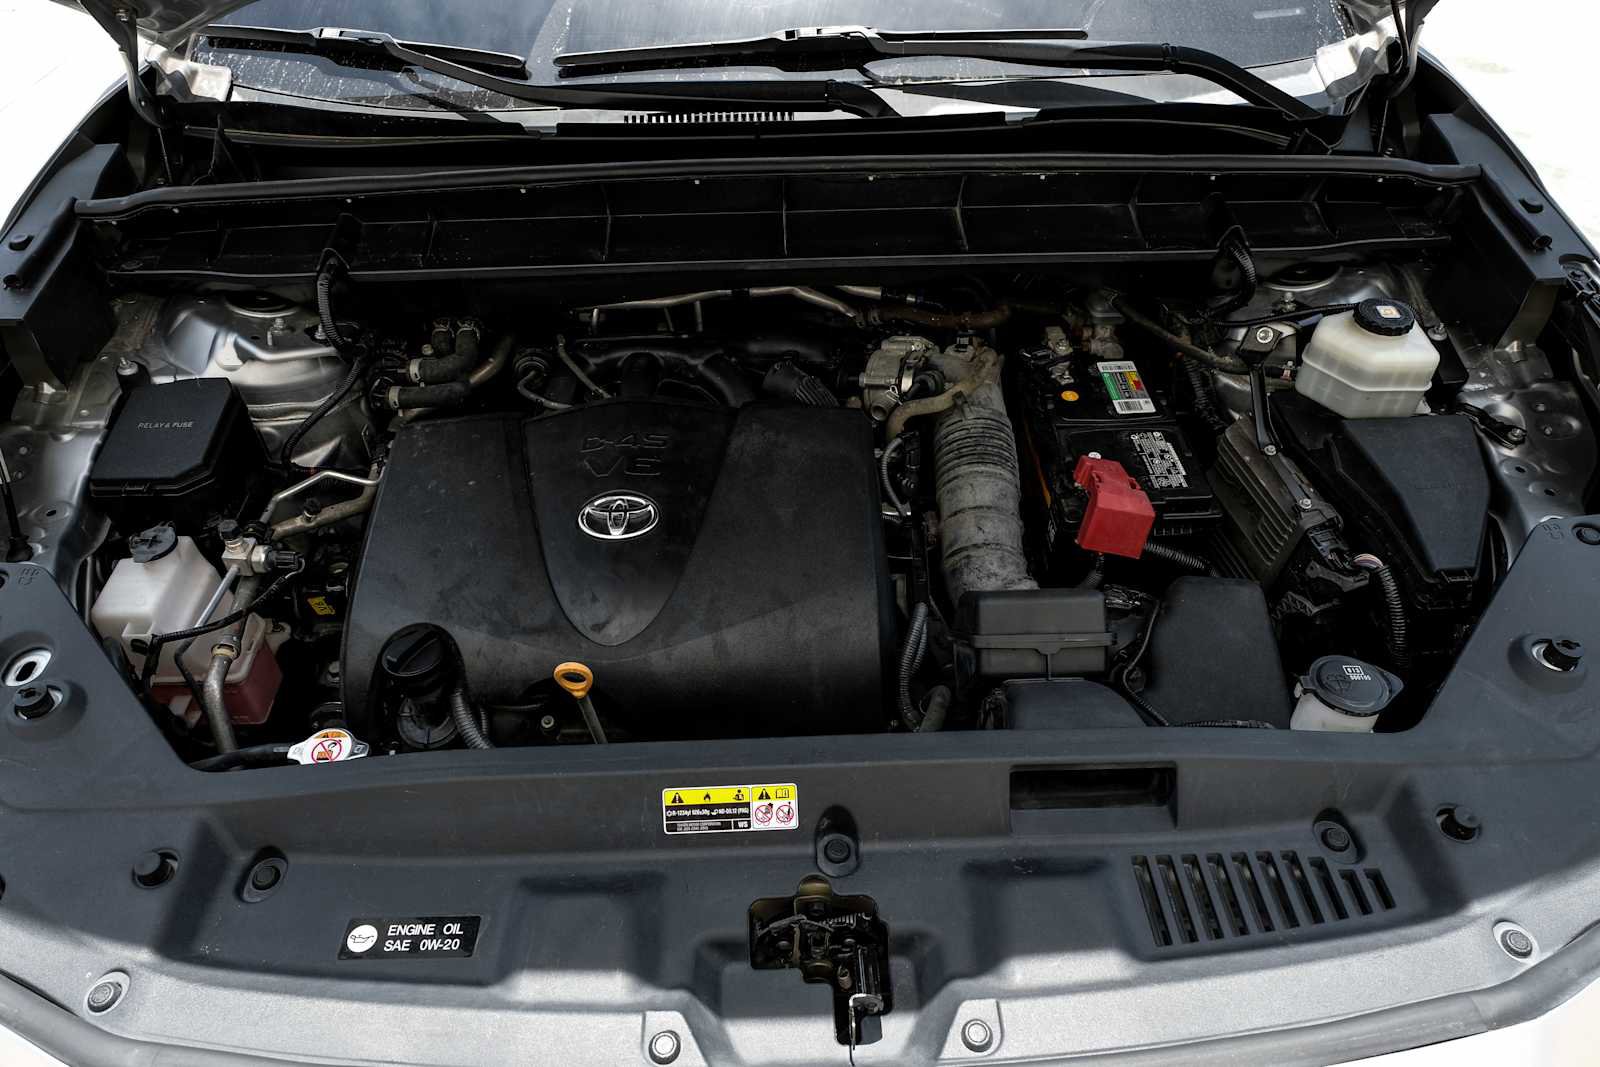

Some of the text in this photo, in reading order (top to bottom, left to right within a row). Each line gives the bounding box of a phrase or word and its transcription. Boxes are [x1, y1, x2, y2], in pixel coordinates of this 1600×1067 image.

[387, 923, 464, 936] ENGINE OIL
[383, 938, 460, 951] SAE 0W-20
